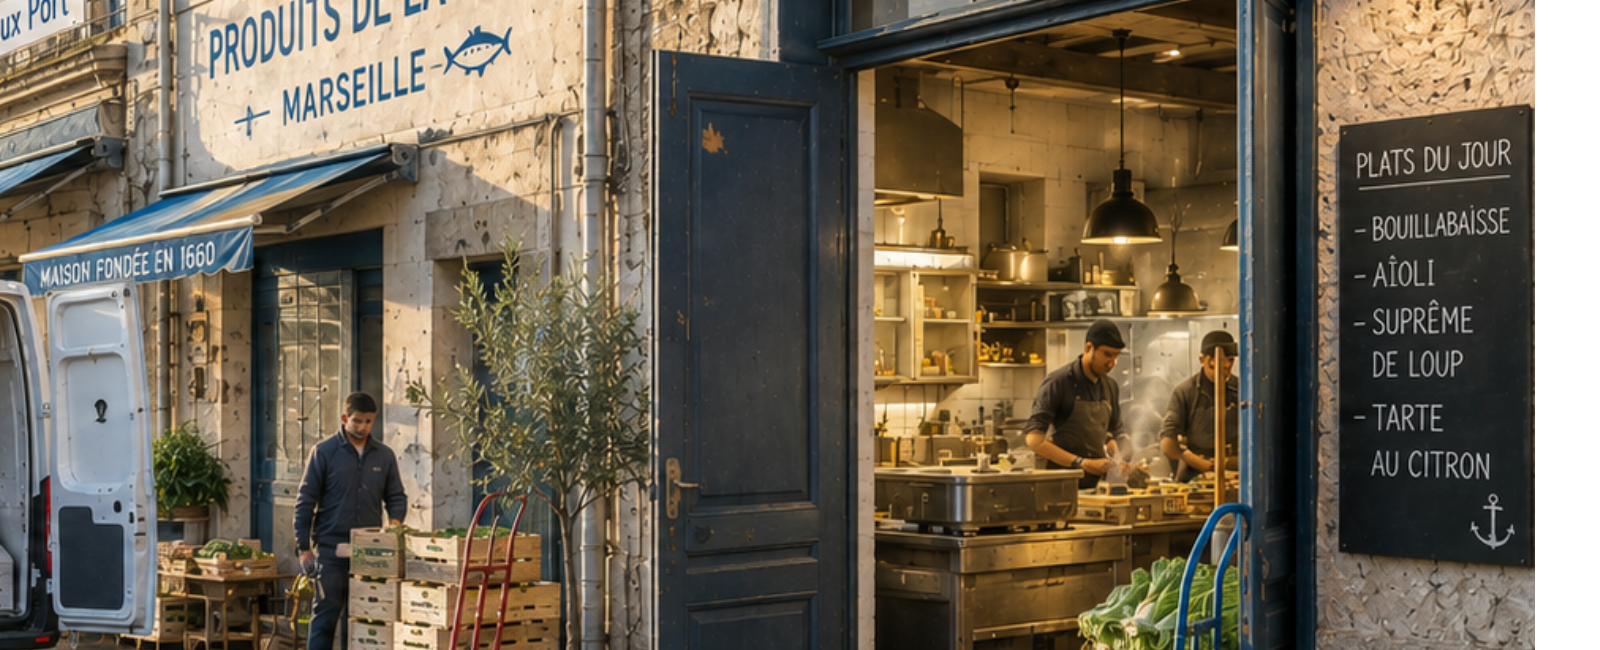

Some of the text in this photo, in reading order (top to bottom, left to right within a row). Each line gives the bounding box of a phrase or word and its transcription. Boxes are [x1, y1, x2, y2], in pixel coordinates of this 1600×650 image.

[210, 0, 341, 80] PRODUITS
[282, 48, 426, 126] MARSEILLE
[1356, 138, 1512, 179] PLATS DU JOUR
[40, 241, 216, 288] MAISON FONDÉE EN 1660
[1372, 299, 1475, 335] SUPRÊME
[1373, 350, 1464, 378] DE LOUP
[1372, 404, 1445, 433] TARTE
[1370, 450, 1491, 481] AU CITRON
